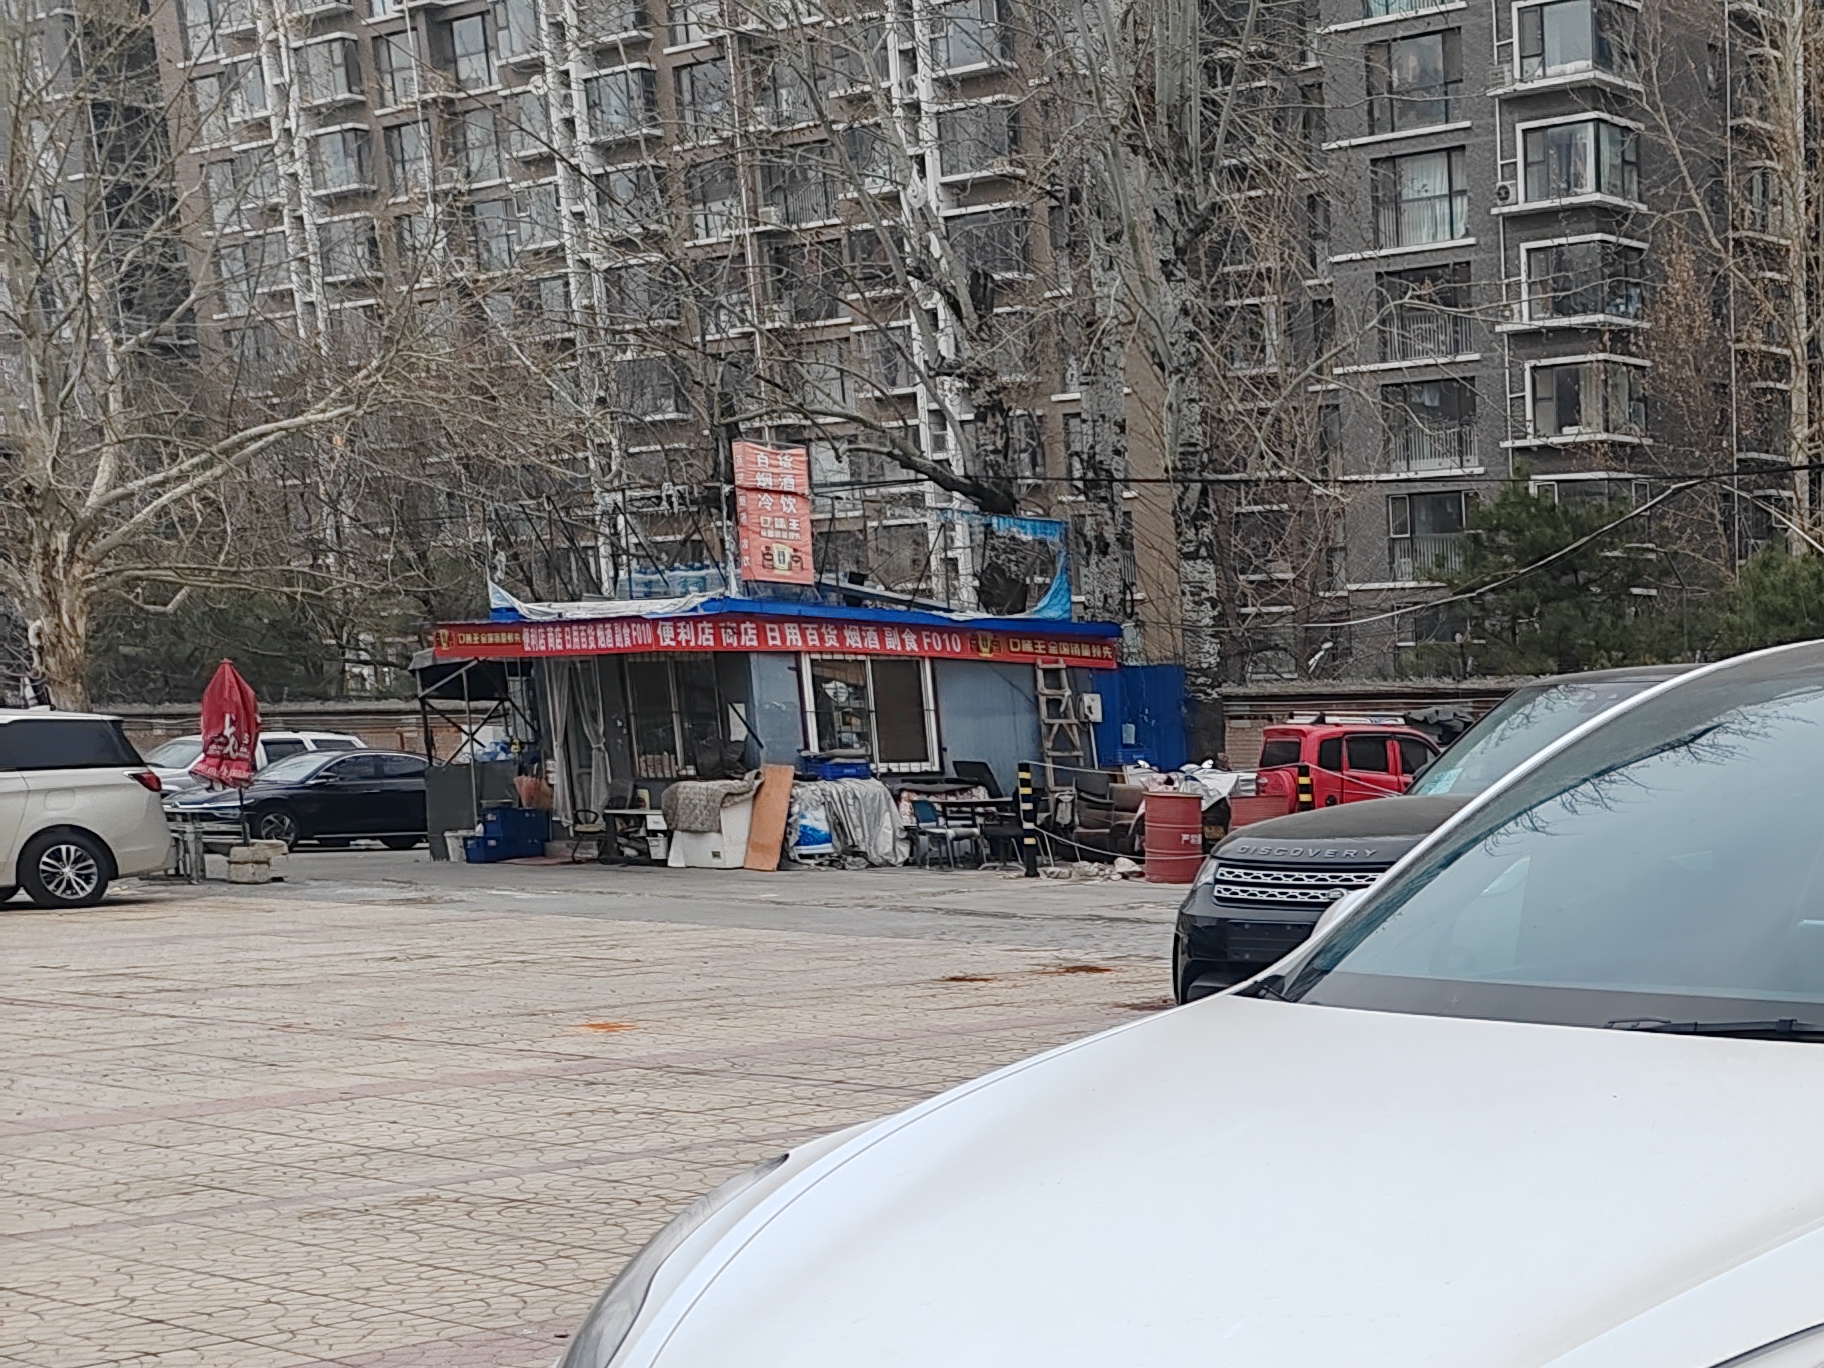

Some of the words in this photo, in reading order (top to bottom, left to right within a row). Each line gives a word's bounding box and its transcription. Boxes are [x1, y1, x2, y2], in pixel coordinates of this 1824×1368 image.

[757, 452, 793, 470] 百货
[756, 472, 795, 491] 烟酒
[758, 493, 797, 514] 冷饮
[522, 626, 545, 652] 便利店
[565, 625, 595, 650] 日用百货
[656, 620, 714, 647] 便利店
[719, 620, 758, 647] 商店
[764, 622, 839, 648] 日用百货
[843, 624, 879, 649] 烟酒
[884, 627, 919, 652] 副食
[921, 631, 961, 653] F010
[1236, 844, 1378, 859] DISCOVERY
